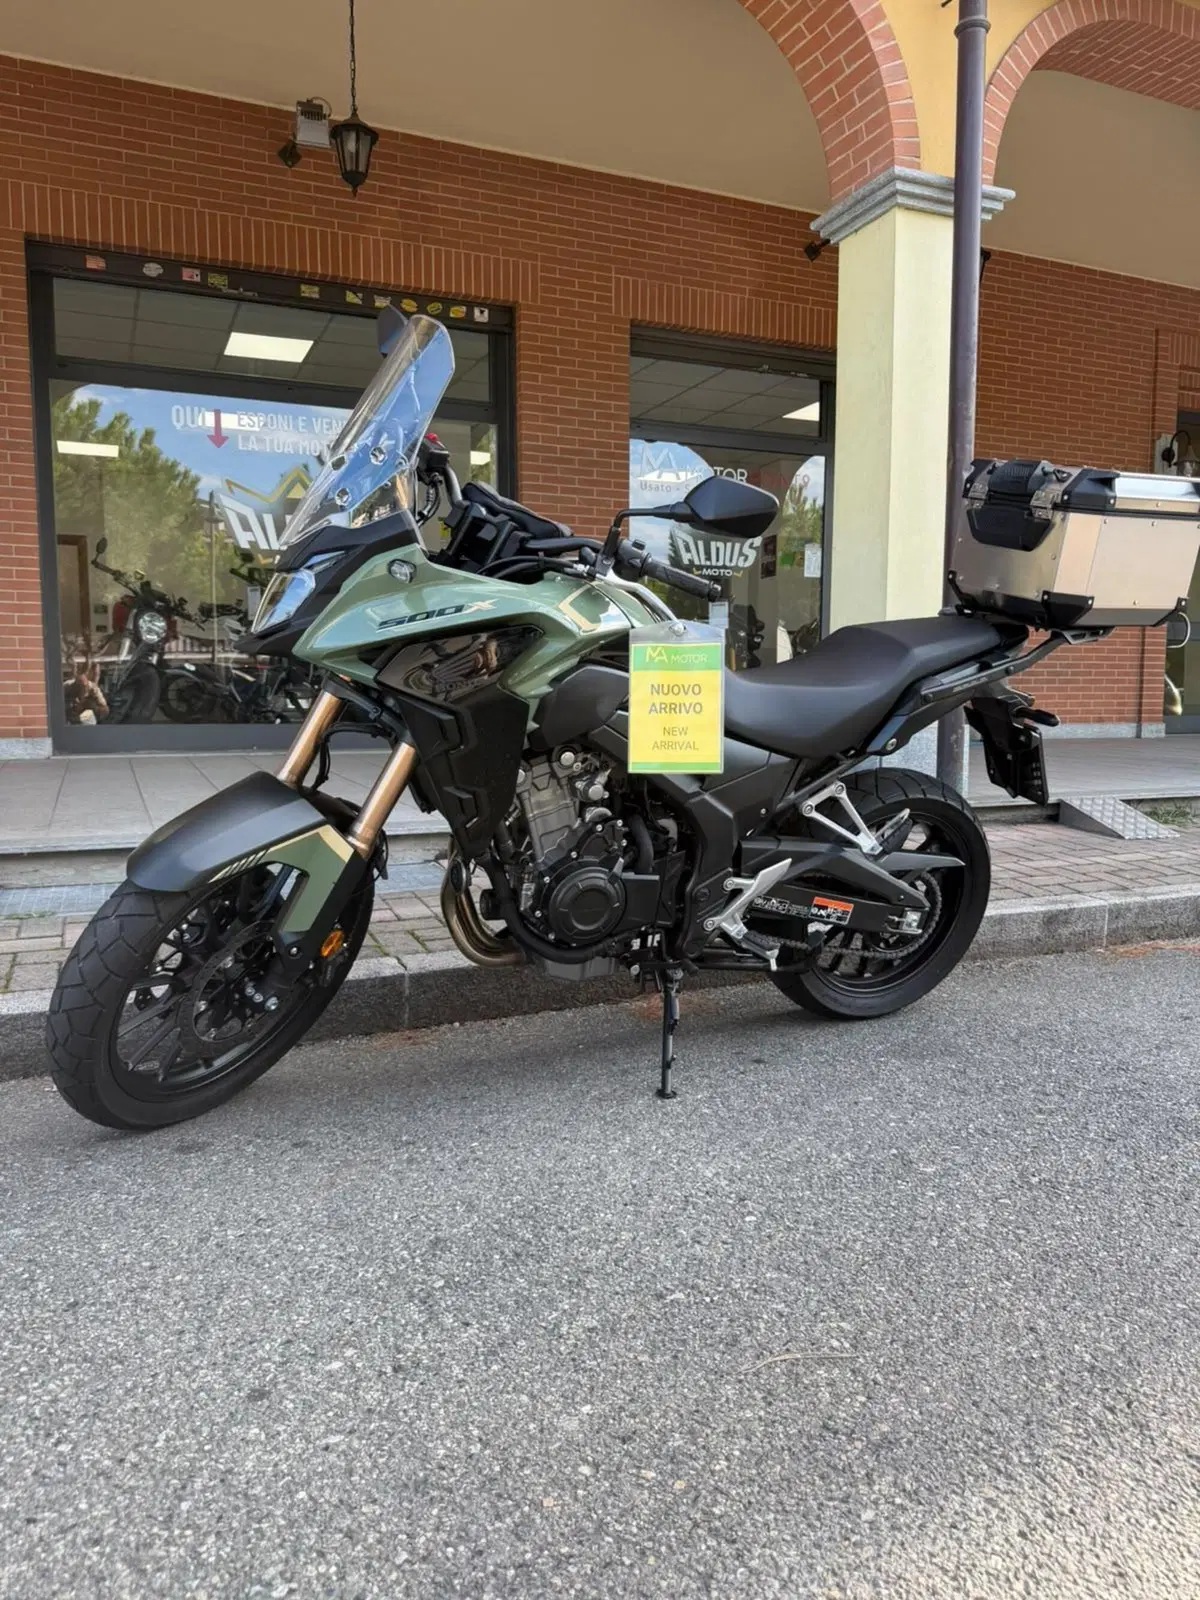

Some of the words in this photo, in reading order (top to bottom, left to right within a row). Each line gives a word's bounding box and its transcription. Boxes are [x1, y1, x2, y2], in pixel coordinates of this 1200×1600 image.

[171, 405, 205, 430] QUI
[238, 411, 295, 432] ESPONI
[298, 415, 308, 433] E
[237, 435, 259, 451] LA
[263, 437, 294, 455] TUA
[299, 439, 334, 457] MOT
[640, 480, 672, 493] Usato
[671, 528, 763, 568] ALDUS
[702, 568, 733, 577] MOTO
[377, 599, 499, 632] 500X
[671, 654, 708, 664] MOTOR
[650, 683, 702, 696] NUOVO
[648, 702, 703, 715] ARRIVO
[662, 726, 689, 737] NEW
[651, 740, 699, 751] ARRIVAL
